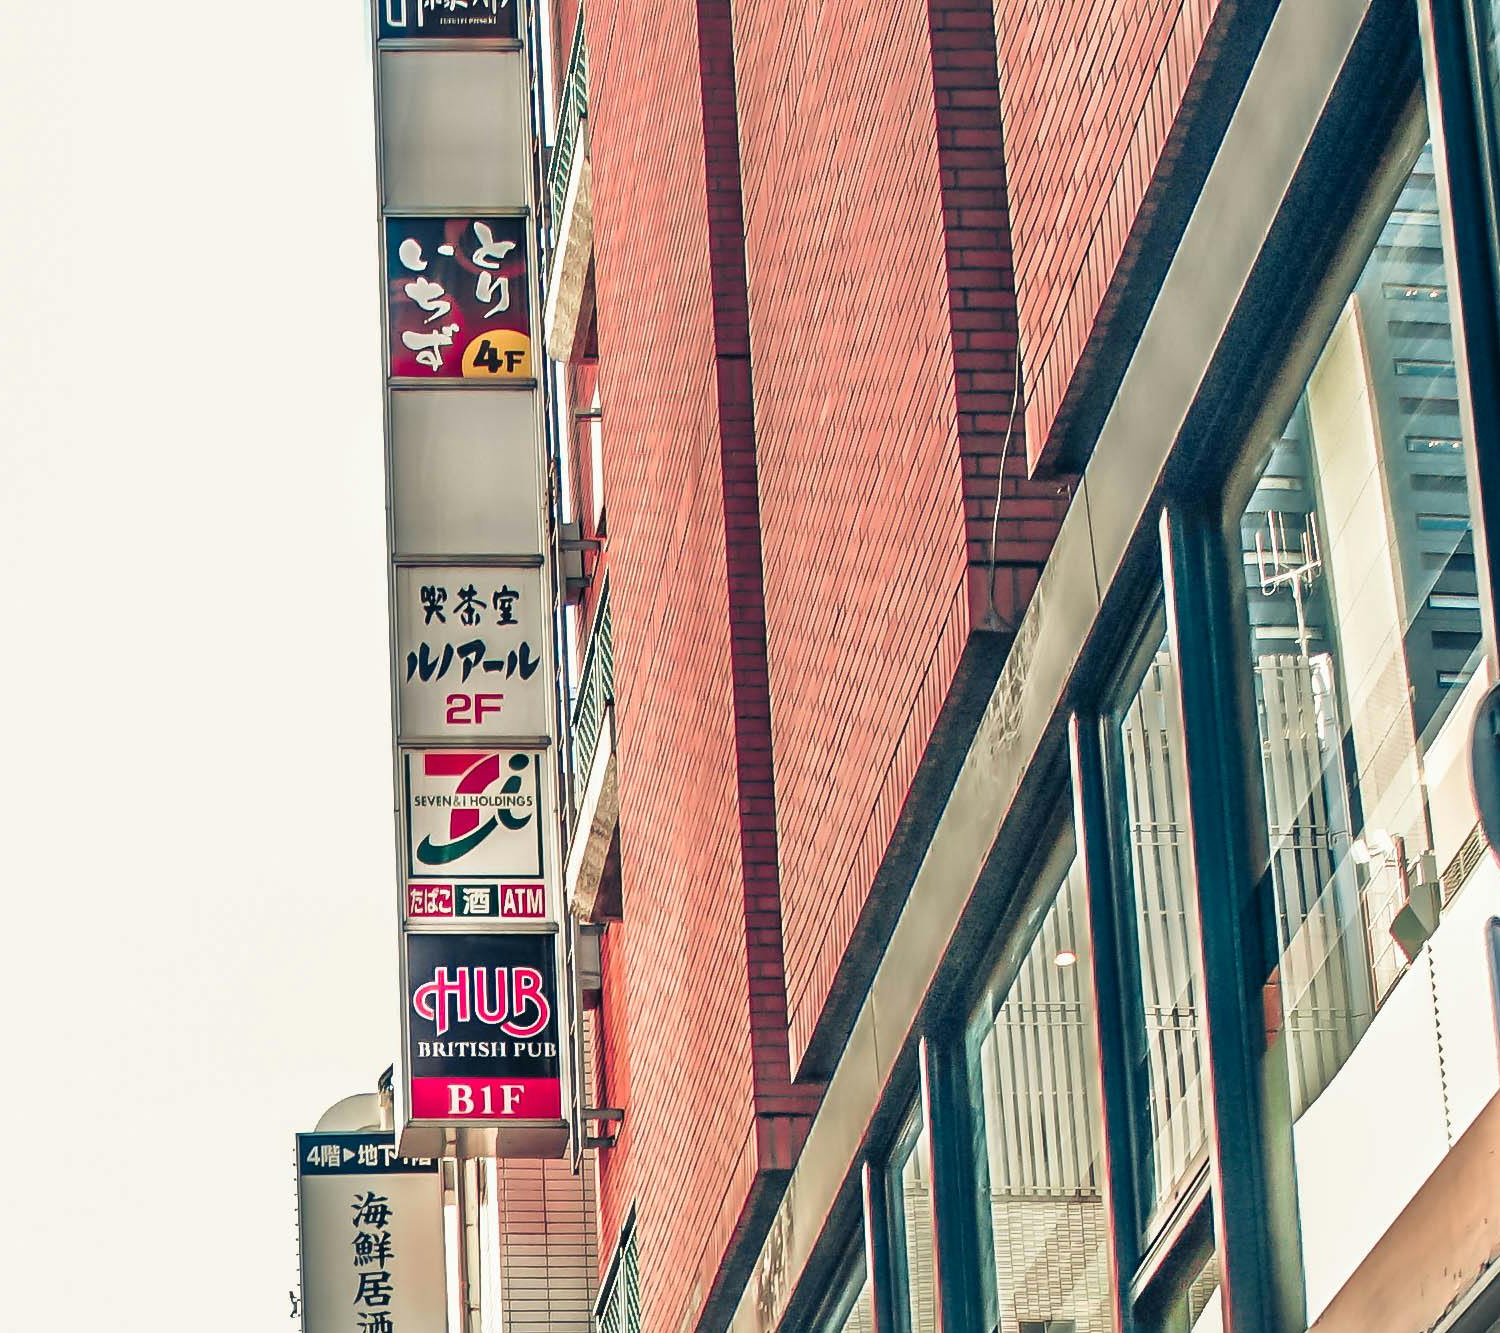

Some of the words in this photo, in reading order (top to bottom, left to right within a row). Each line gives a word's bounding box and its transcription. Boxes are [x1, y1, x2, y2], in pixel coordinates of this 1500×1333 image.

[474, 219, 517, 319] とり
[473, 337, 526, 374] 4F
[420, 584, 520, 627] 喫茶室
[407, 640, 540, 684] ルノアール
[446, 693, 504, 724] 2F
[470, 795, 532, 806] HOLDINGS
[410, 888, 451, 914] たばこ
[463, 888, 490, 914] 酒
[504, 888, 543, 914] ATM
[413, 966, 551, 1038] HUB
[418, 1041, 507, 1058] BRITISH
[513, 1042, 556, 1059] PUB
[447, 1084, 526, 1116] B1F
[307, 1145, 341, 1167] 4階
